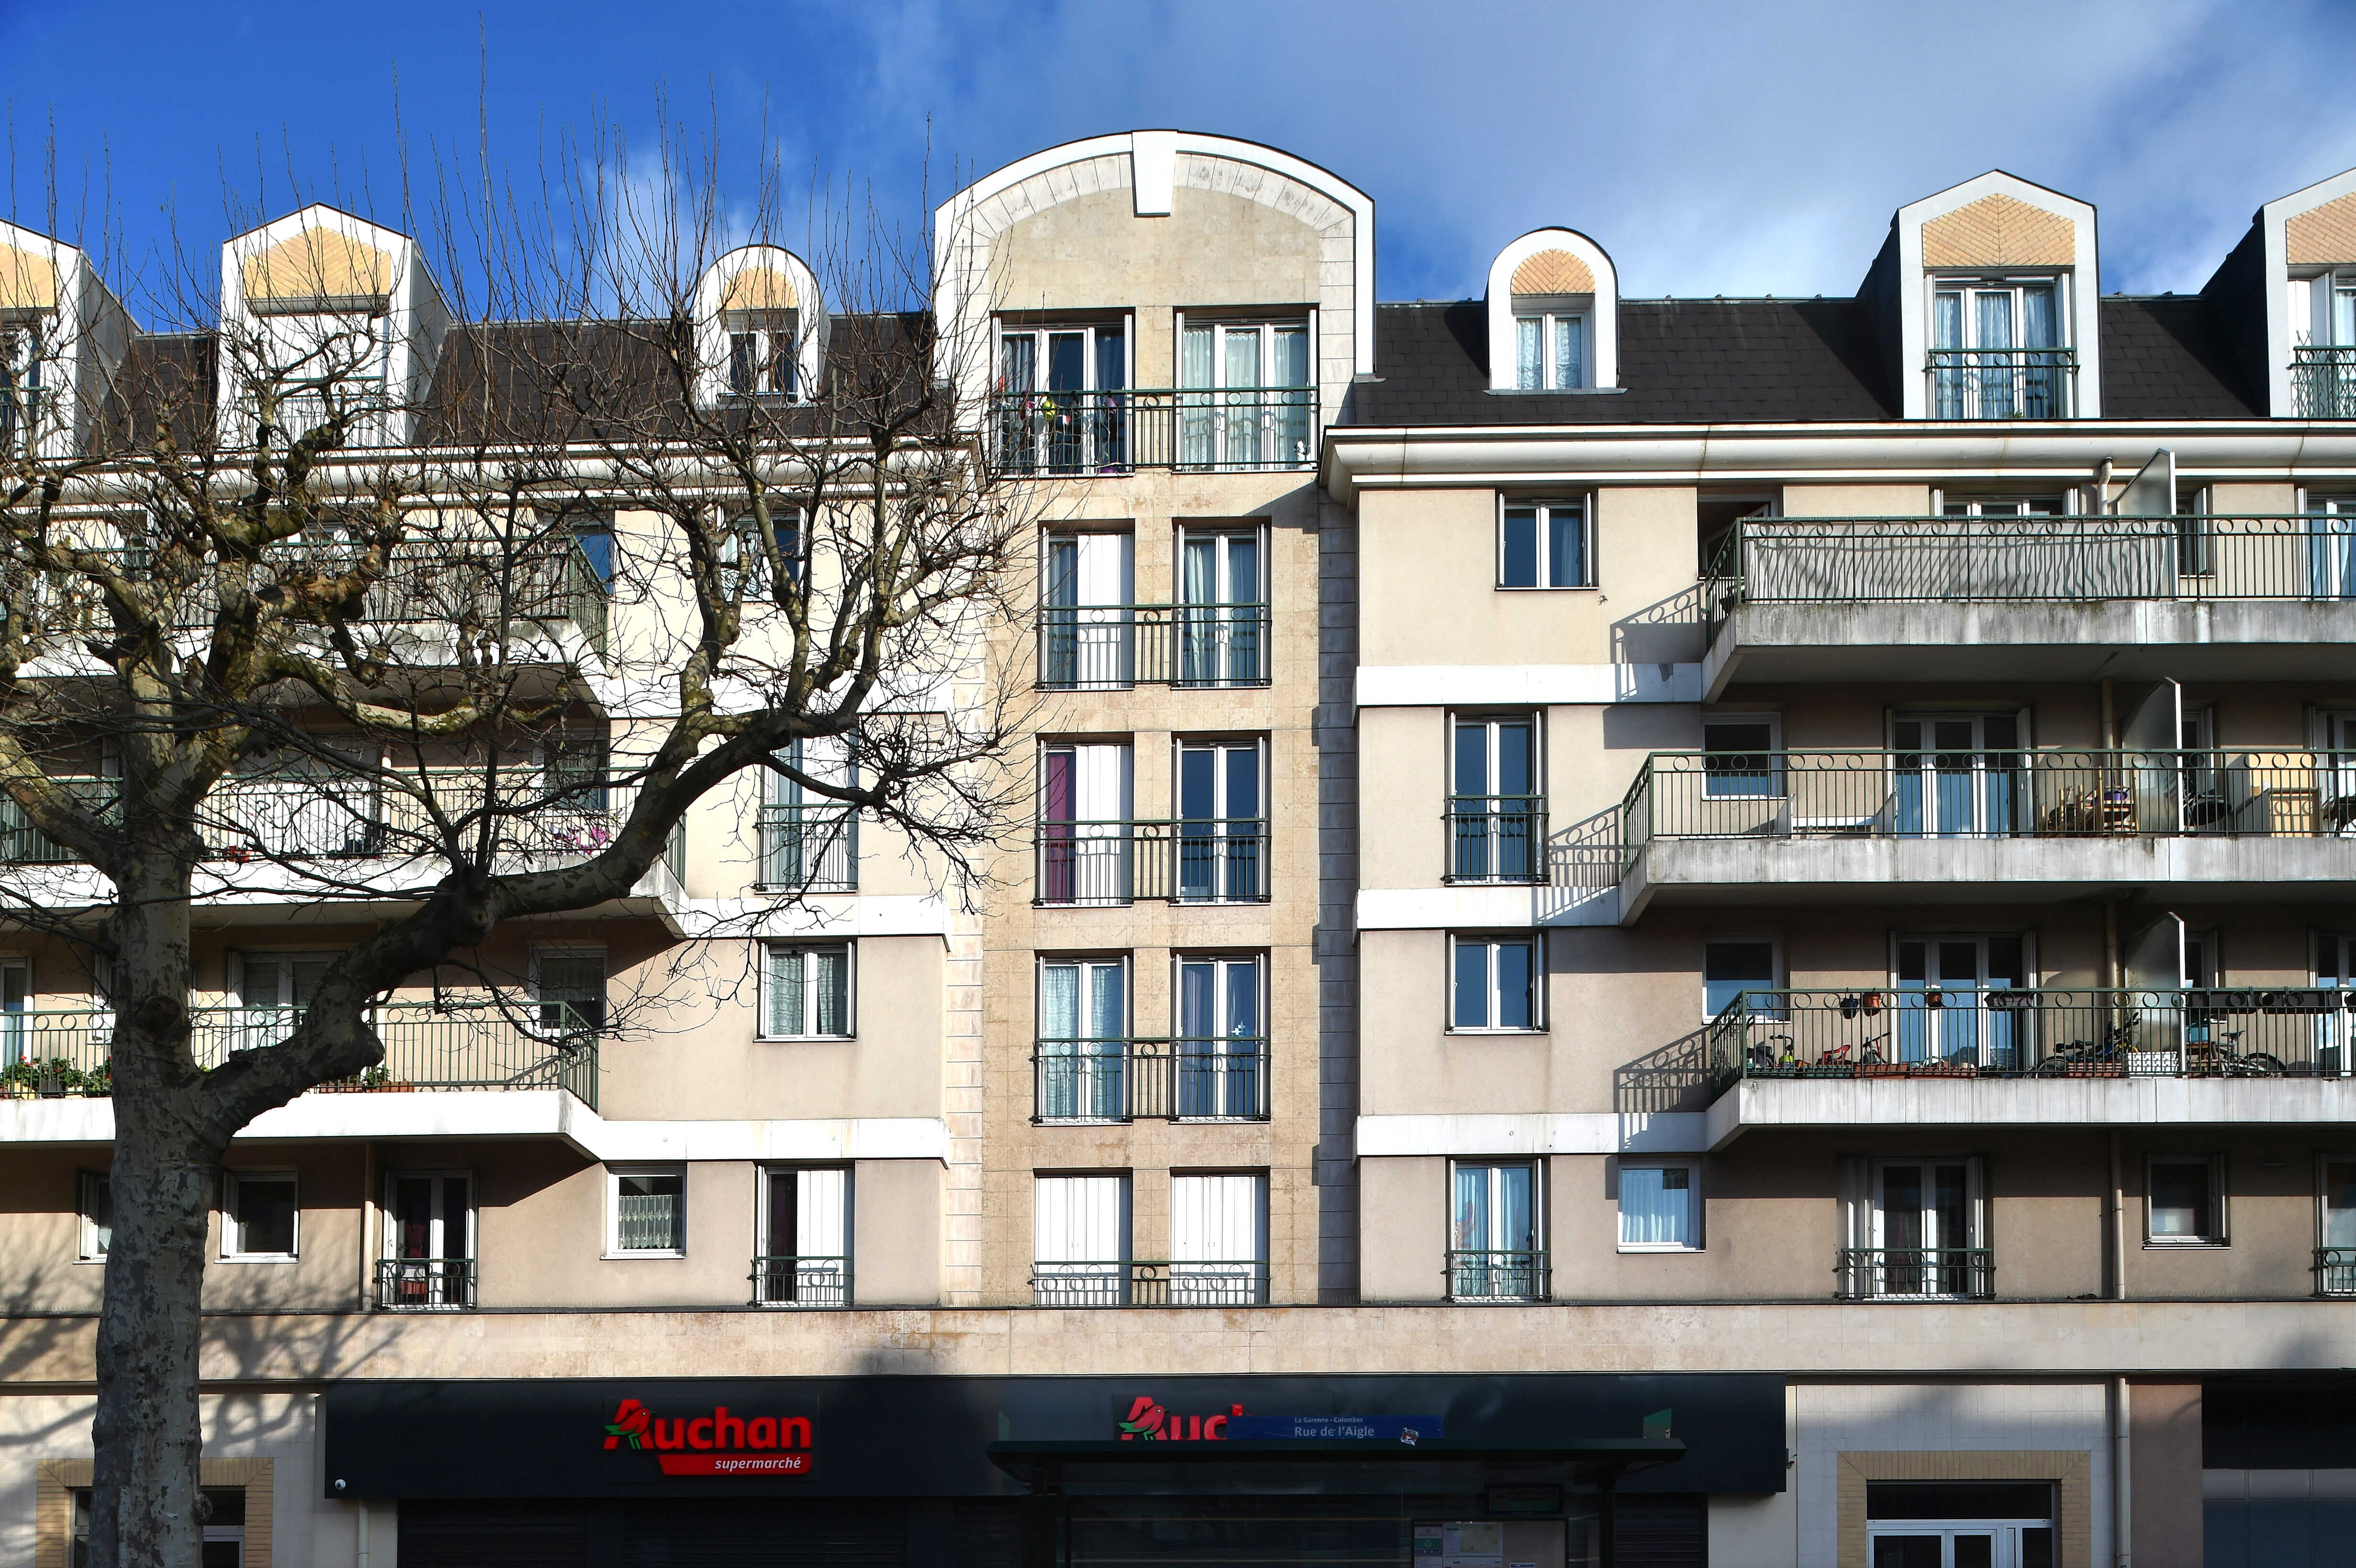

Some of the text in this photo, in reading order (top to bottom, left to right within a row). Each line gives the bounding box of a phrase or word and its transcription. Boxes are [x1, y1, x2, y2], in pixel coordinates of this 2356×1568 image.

[603, 1399, 811, 1450] Auchan
[1119, 1396, 1244, 1440] Auc
[1295, 1426, 1374, 1438] Rue de l'Aigle
[715, 1457, 801, 1472] supermarché
